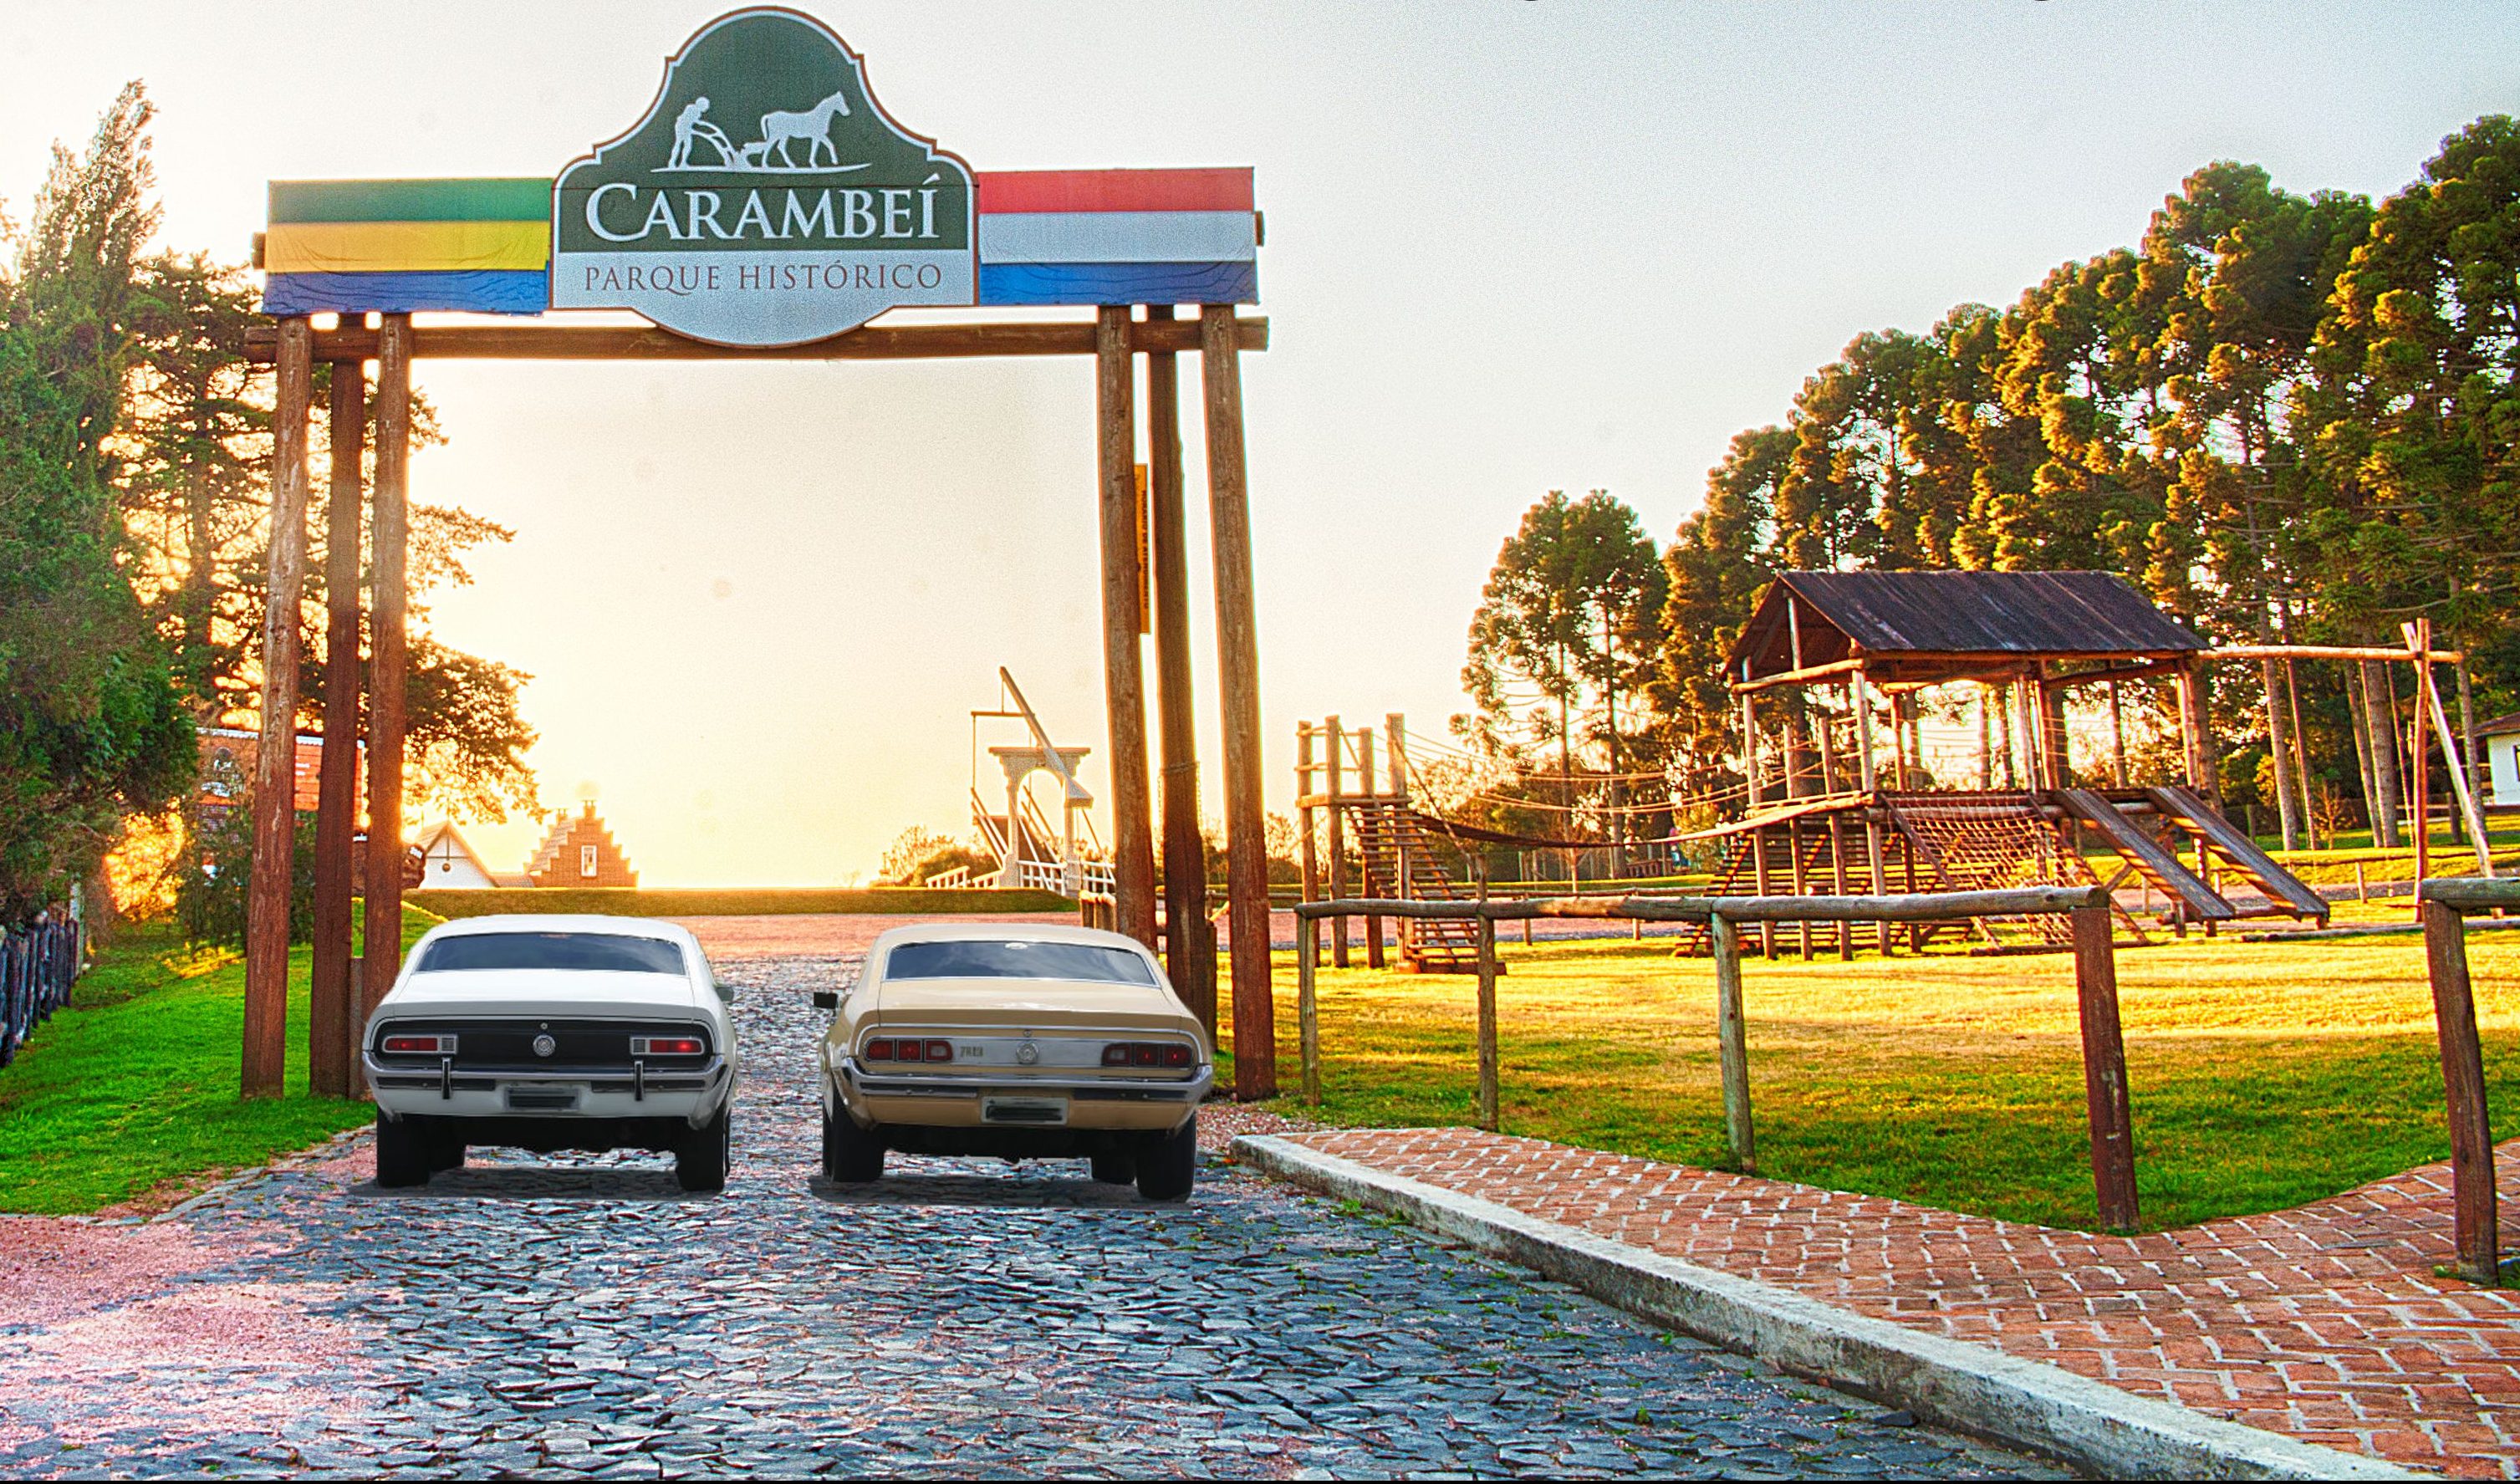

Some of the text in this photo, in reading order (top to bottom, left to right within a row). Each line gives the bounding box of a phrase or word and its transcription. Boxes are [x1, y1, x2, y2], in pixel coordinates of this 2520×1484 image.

[586, 174, 940, 242] CARAMBEÍ
[585, 260, 941, 296] PARQUE HISTÓRICO
